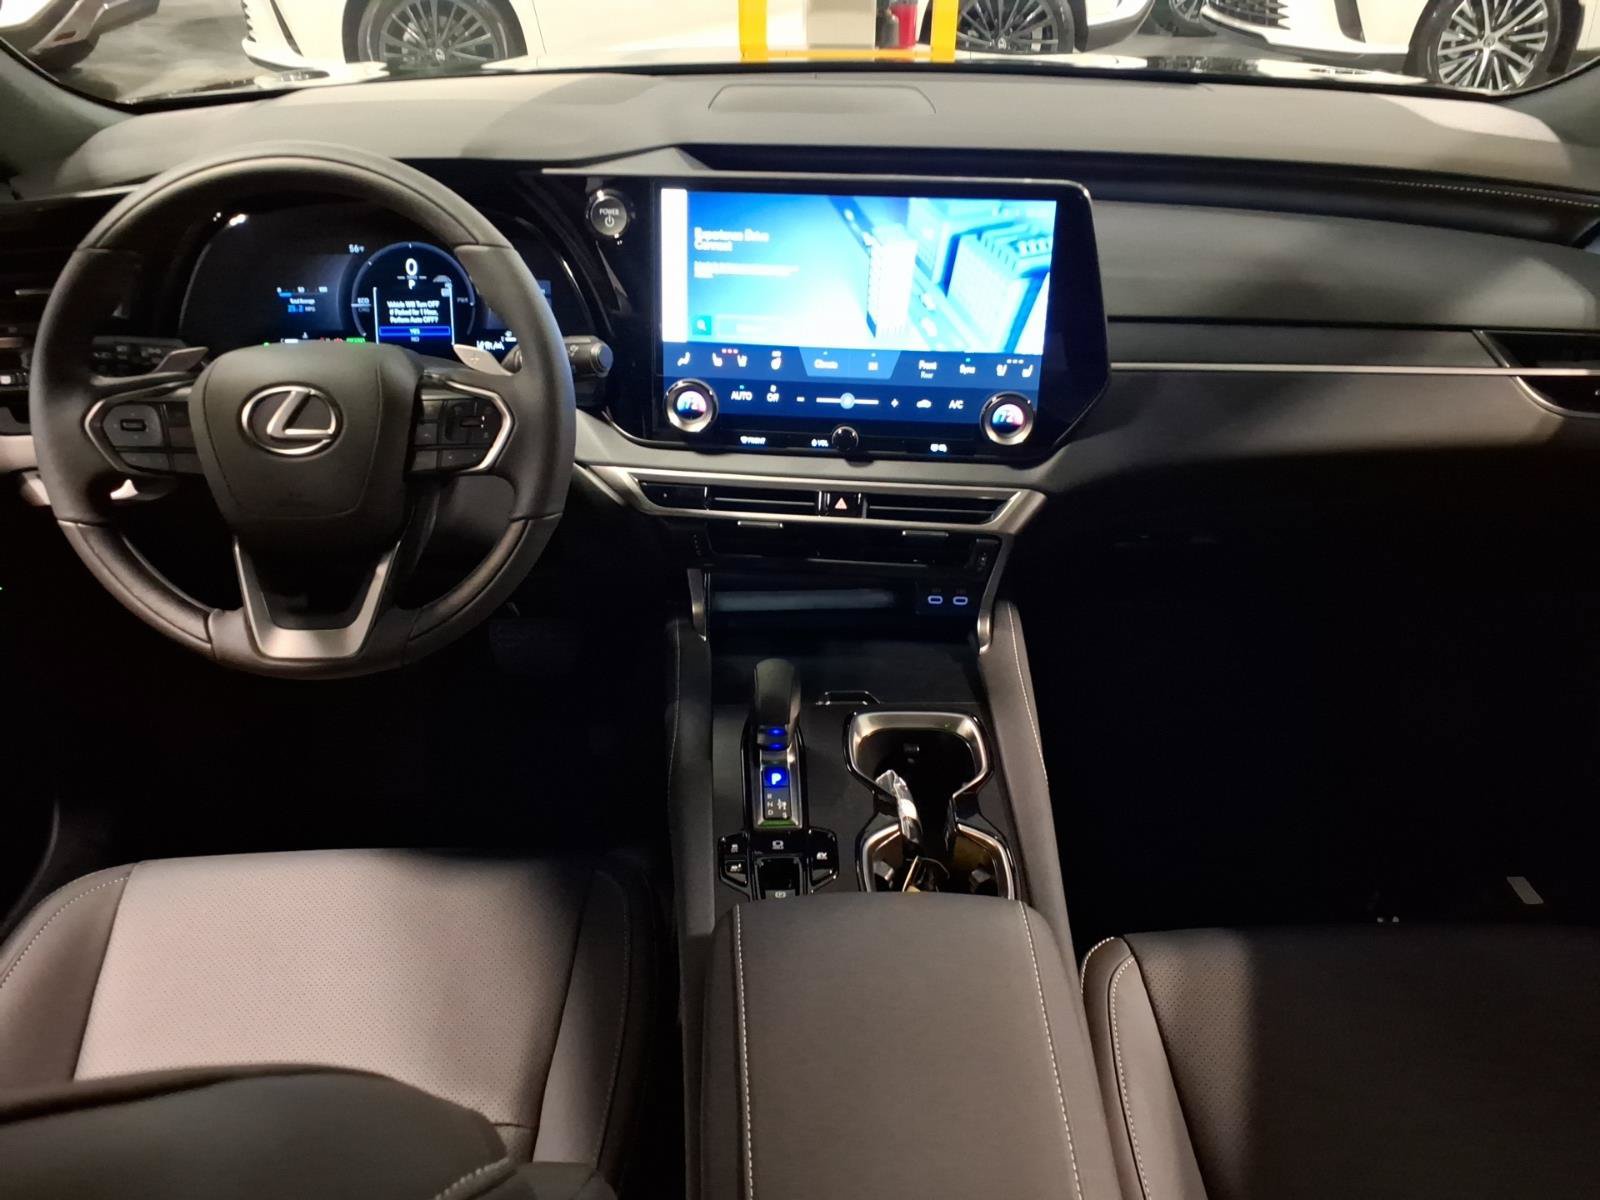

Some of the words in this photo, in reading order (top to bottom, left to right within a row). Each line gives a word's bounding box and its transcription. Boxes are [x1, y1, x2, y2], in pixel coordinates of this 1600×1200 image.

[599, 207, 620, 216] POWER
[405, 258, 418, 276] 0
[427, 300, 440, 308] OFF
[730, 391, 753, 401] AUTO
[766, 392, 780, 403] OFF
[948, 399, 964, 410] A/C
[771, 773, 782, 785] P
